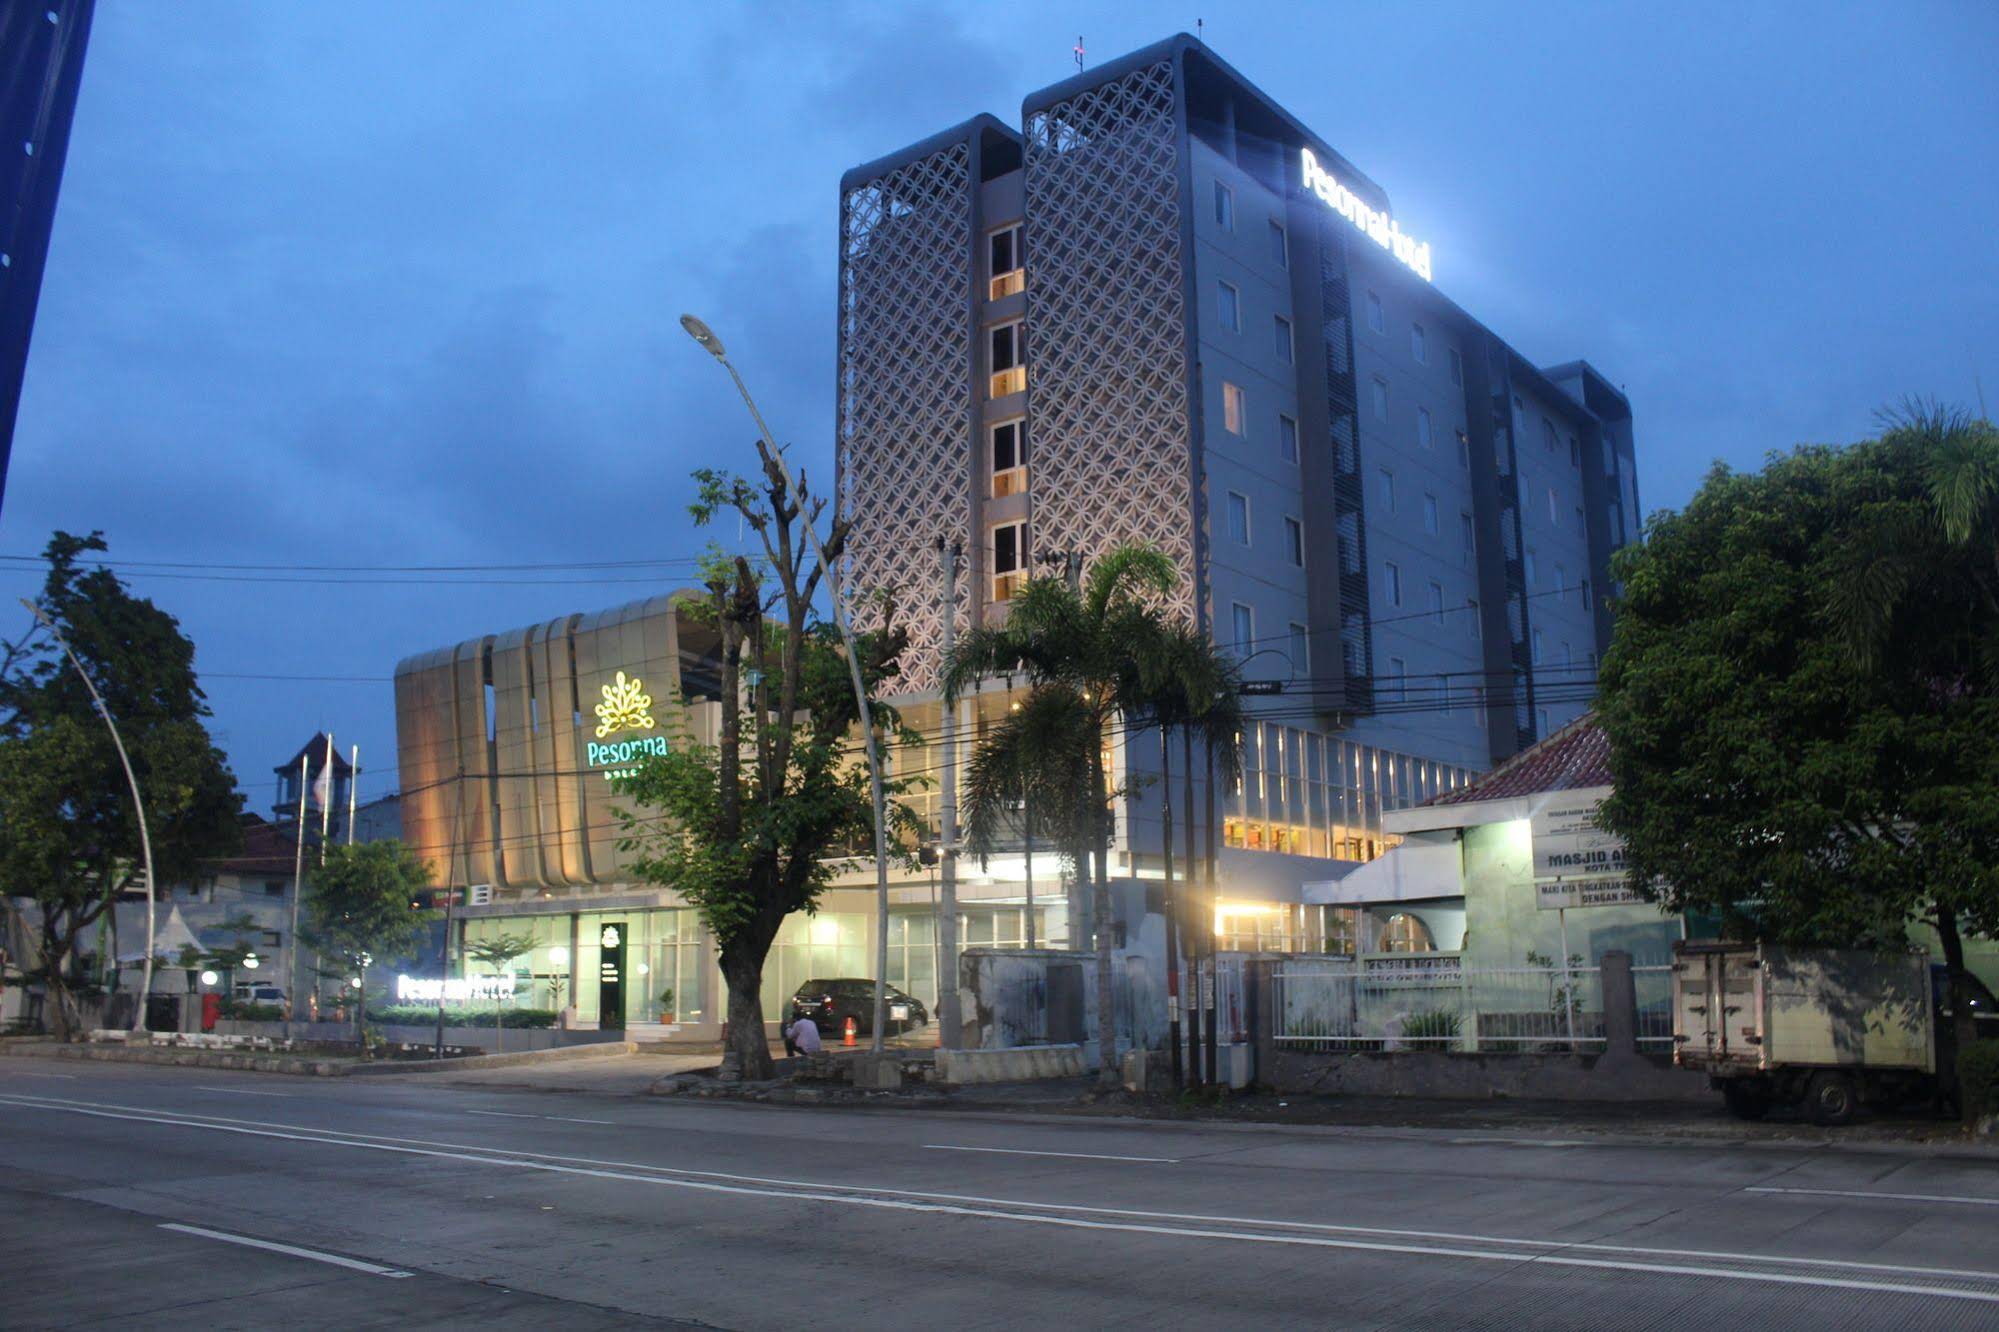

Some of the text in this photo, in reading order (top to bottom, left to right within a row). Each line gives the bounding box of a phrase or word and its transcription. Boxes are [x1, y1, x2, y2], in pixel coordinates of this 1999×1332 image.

[1548, 850, 1607, 867] MASJID
[1584, 863, 1611, 873] KOTA
[1582, 893, 1618, 904] DENGAN
